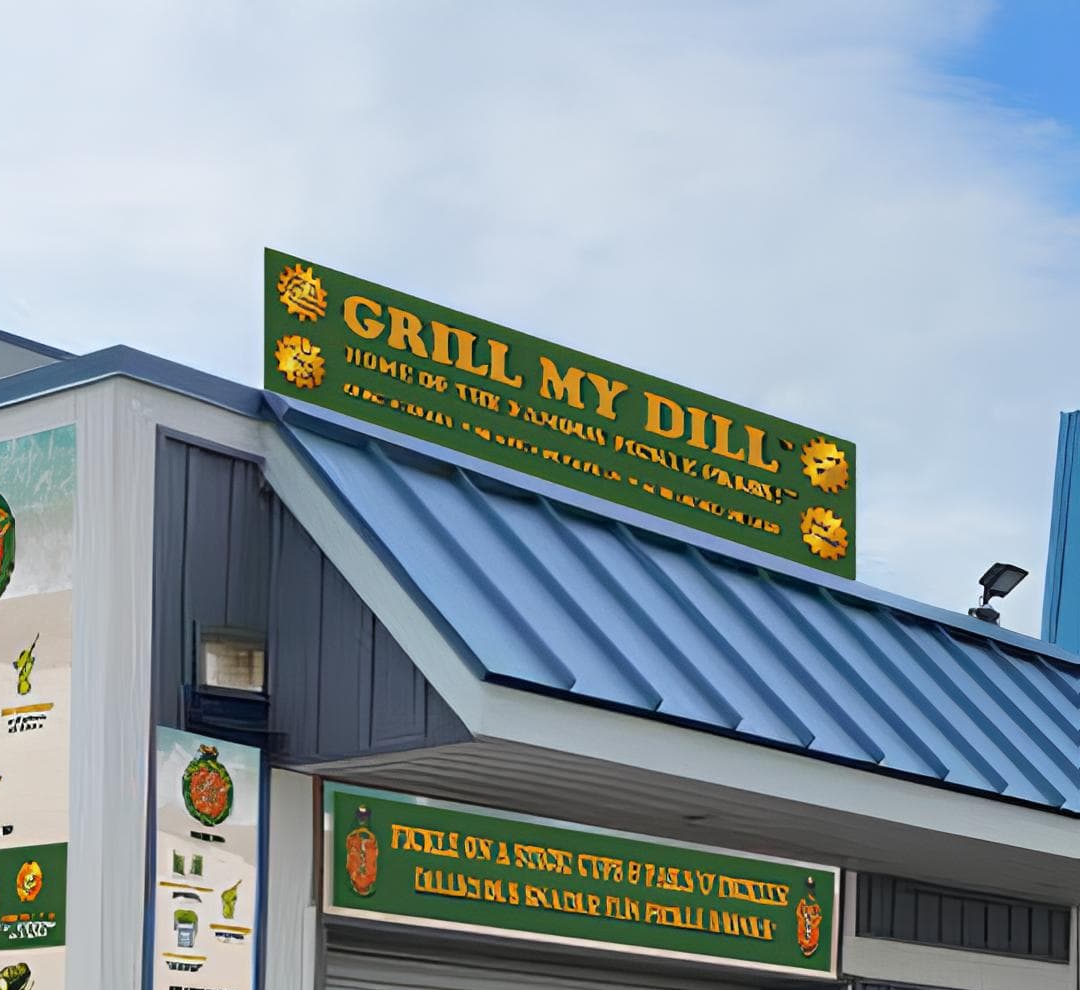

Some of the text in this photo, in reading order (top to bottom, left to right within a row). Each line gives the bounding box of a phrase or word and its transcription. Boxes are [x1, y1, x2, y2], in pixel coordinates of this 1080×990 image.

[343, 295, 522, 389] GRILL
[539, 356, 628, 420] MY
[644, 391, 780, 474] DILL
